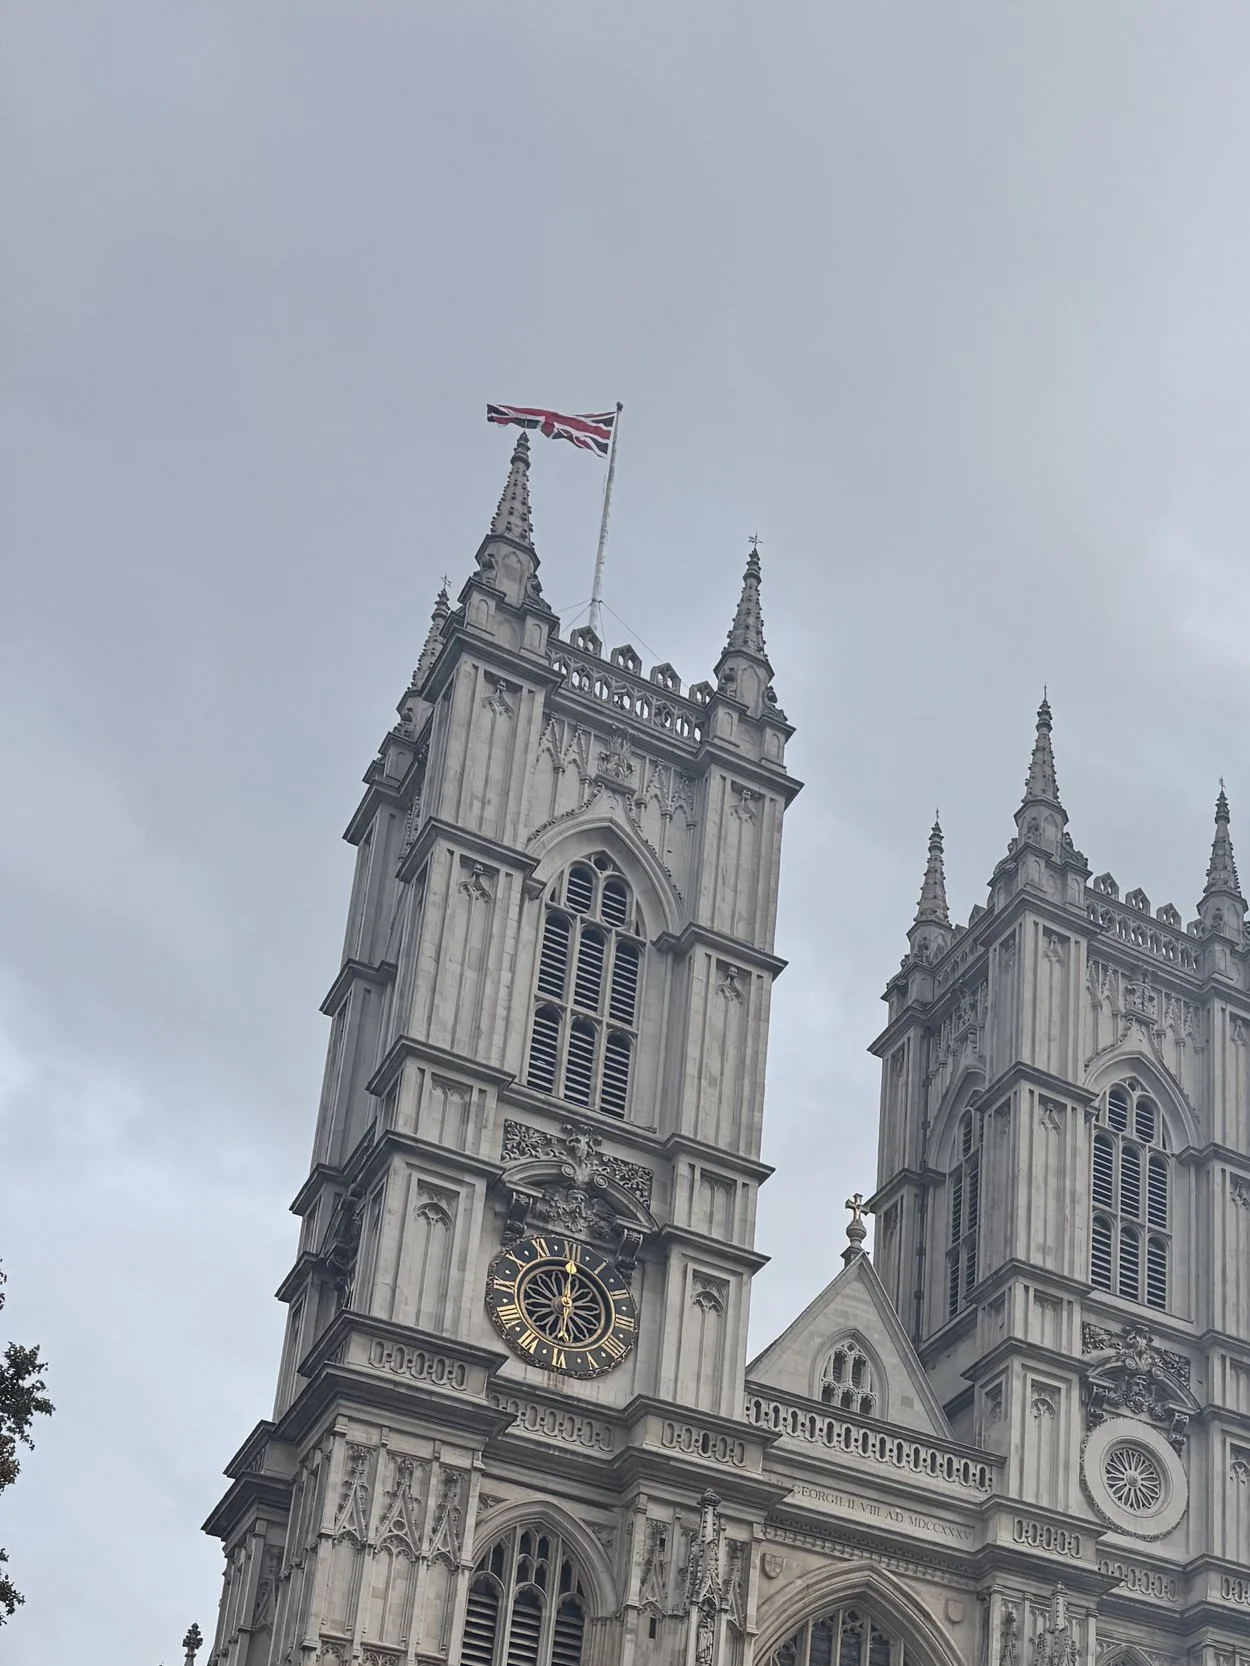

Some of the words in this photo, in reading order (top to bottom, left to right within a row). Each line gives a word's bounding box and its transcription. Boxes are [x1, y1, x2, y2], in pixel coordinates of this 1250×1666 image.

[531, 1238, 551, 1259] XI
[505, 1251, 527, 1271] X
[594, 1261, 608, 1275] I
[610, 1288, 631, 1301] II
[615, 1313, 635, 1332] III
[517, 1329, 539, 1355] VII
[552, 1347, 567, 1369] VI
[586, 1351, 600, 1370] V
